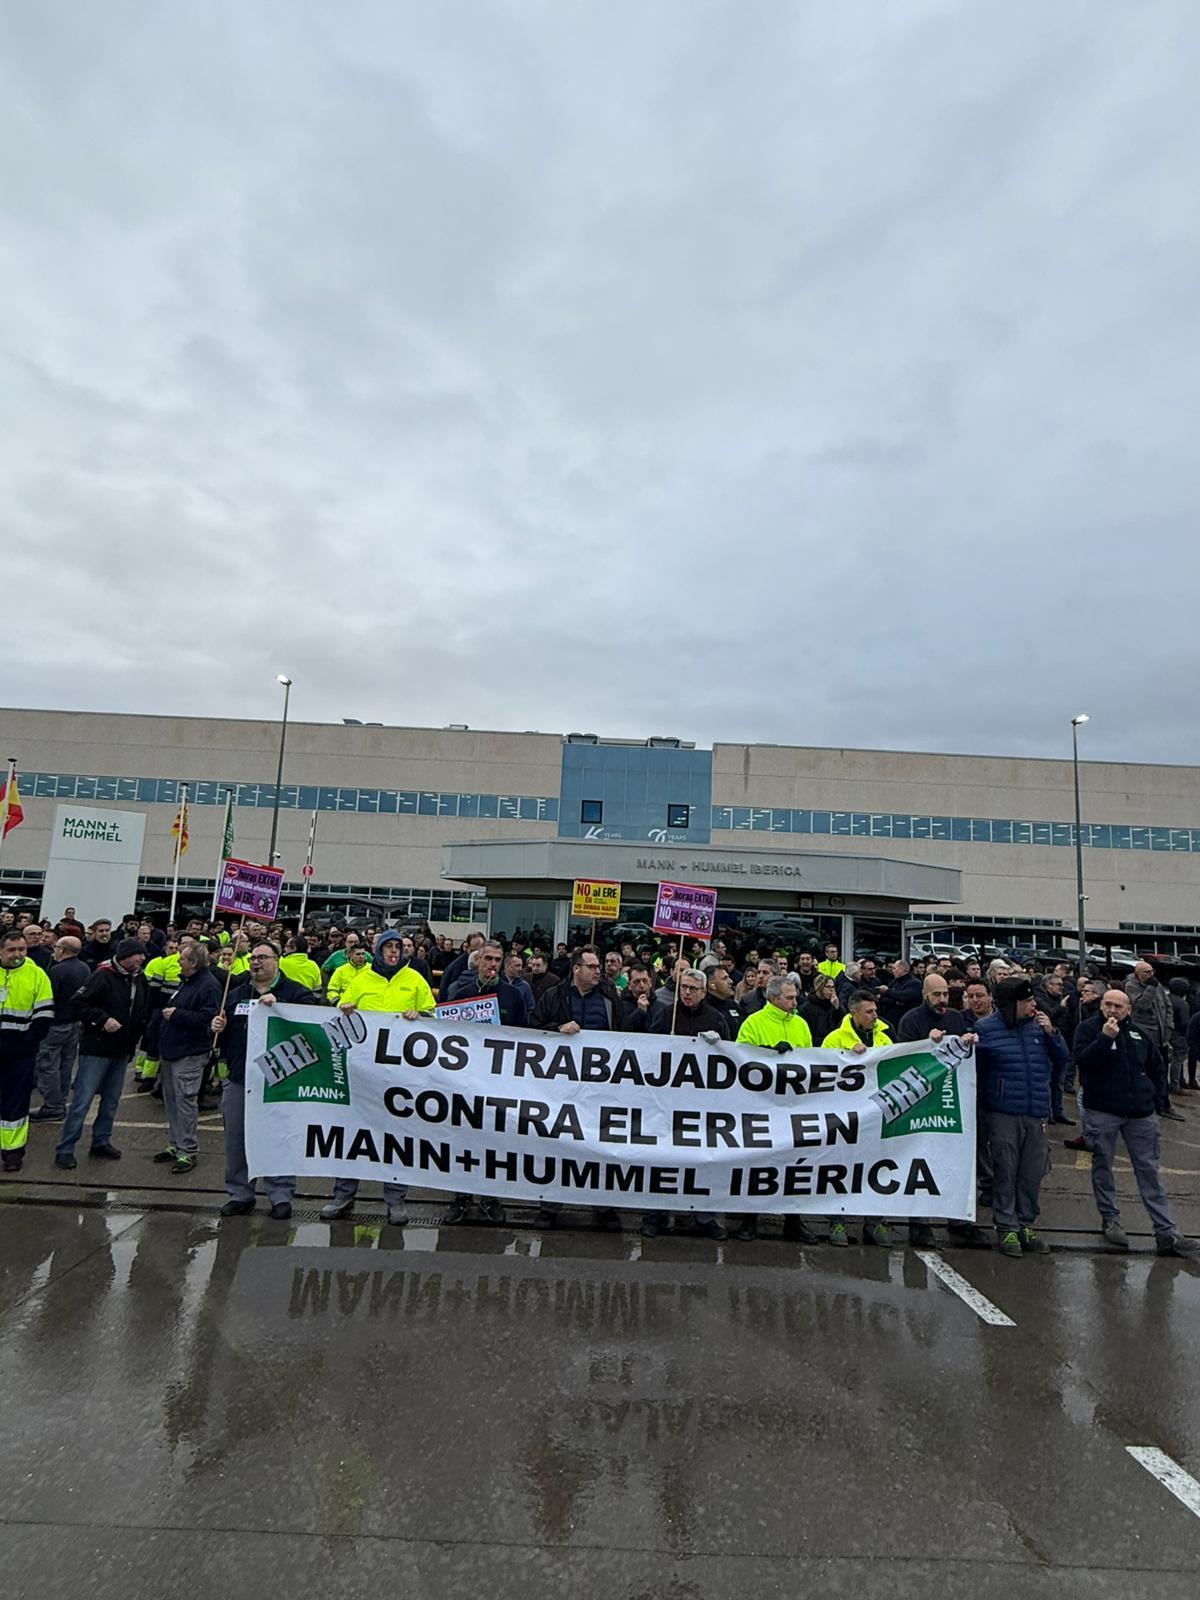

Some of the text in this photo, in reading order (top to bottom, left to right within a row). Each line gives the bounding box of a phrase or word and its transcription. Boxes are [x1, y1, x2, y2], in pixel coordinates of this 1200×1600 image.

[62, 828, 122, 842] HUMMEL
[636, 858, 675, 871] MANN
[692, 861, 746, 874] HUMMEL
[221, 885, 234, 899] NO
[576, 884, 618, 898] NO al ERE
[694, 893, 713, 905] EXTRA
[659, 906, 671, 920] NO
[680, 911, 693, 923] ERE
[442, 1008, 458, 1017] NO
[476, 1002, 492, 1010] NO
[320, 1010, 367, 1050] NO
[253, 1033, 321, 1088] ERE
[375, 1028, 866, 1095] LOS TRABAJADORES
[298, 1085, 346, 1099] MANN+
[868, 1065, 934, 1124] ERE
[383, 1086, 858, 1148] CONTRA EL ERE EN
[910, 1115, 957, 1131] MANN+
[305, 1124, 941, 1196] MANN+HUMMEL IBÉRICA
